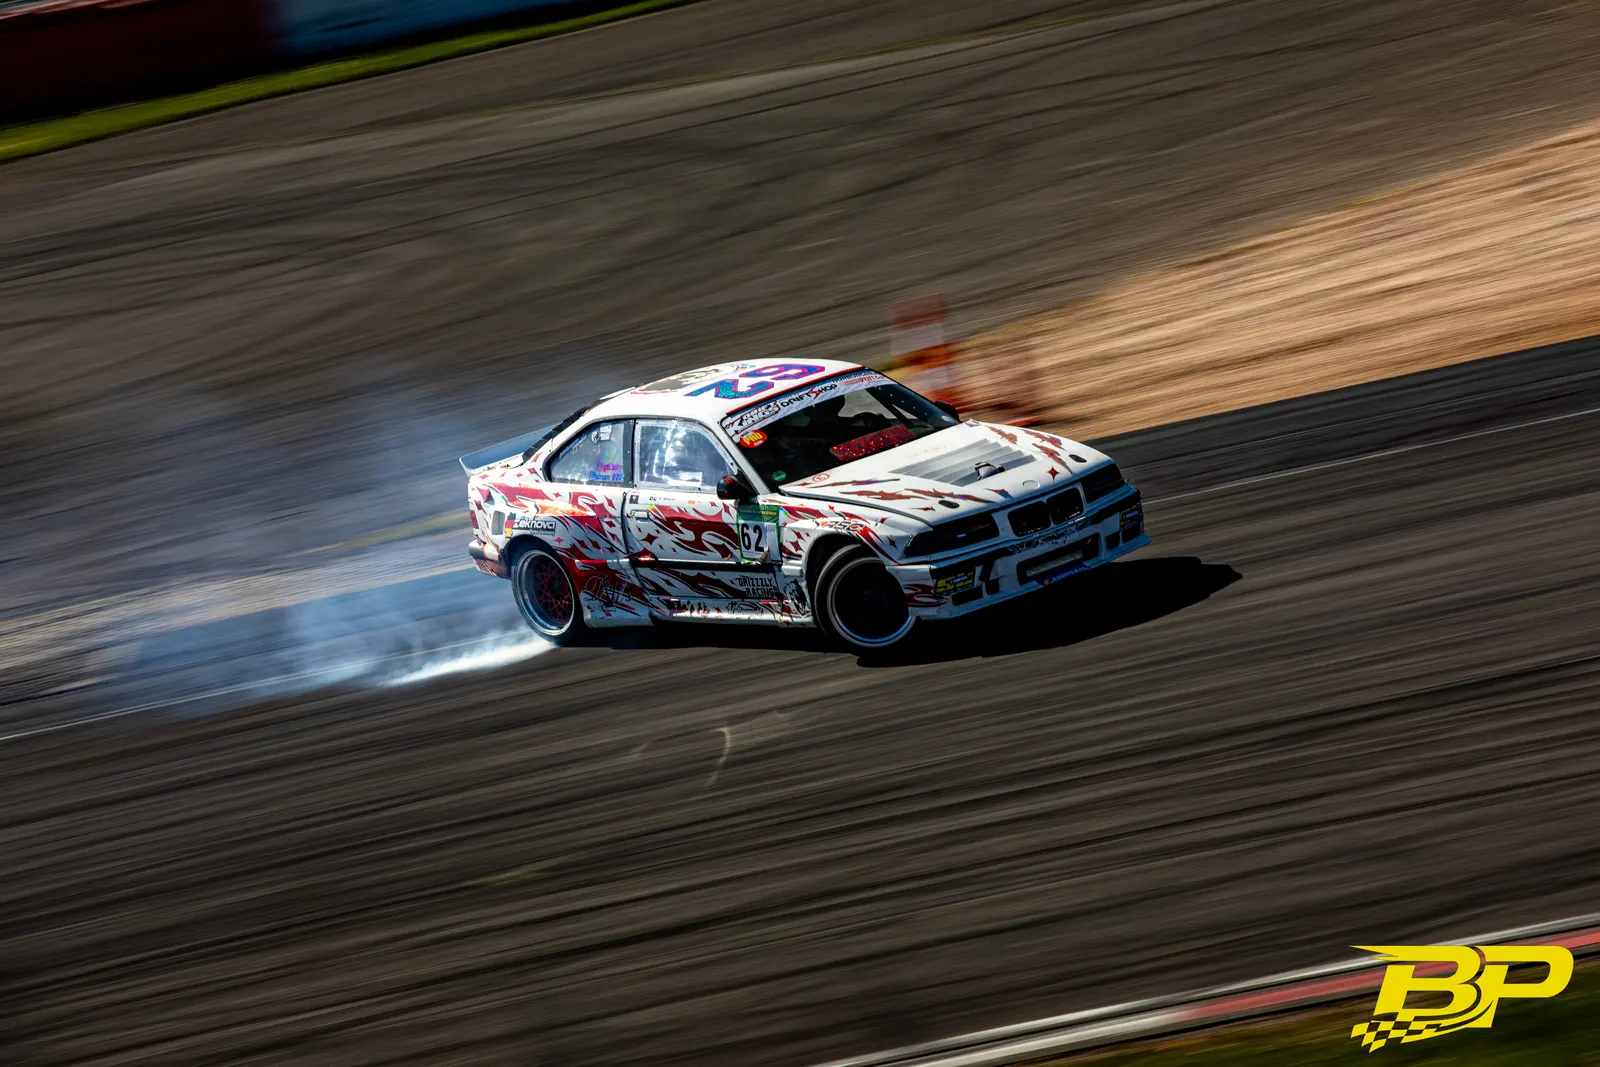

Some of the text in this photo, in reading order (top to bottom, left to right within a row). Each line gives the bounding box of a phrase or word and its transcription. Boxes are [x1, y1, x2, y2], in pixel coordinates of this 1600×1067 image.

[743, 432, 763, 445] PRO
[741, 523, 764, 552] 62
[738, 577, 772, 587] GRIZZZLY
[745, 587, 774, 597] RACING
